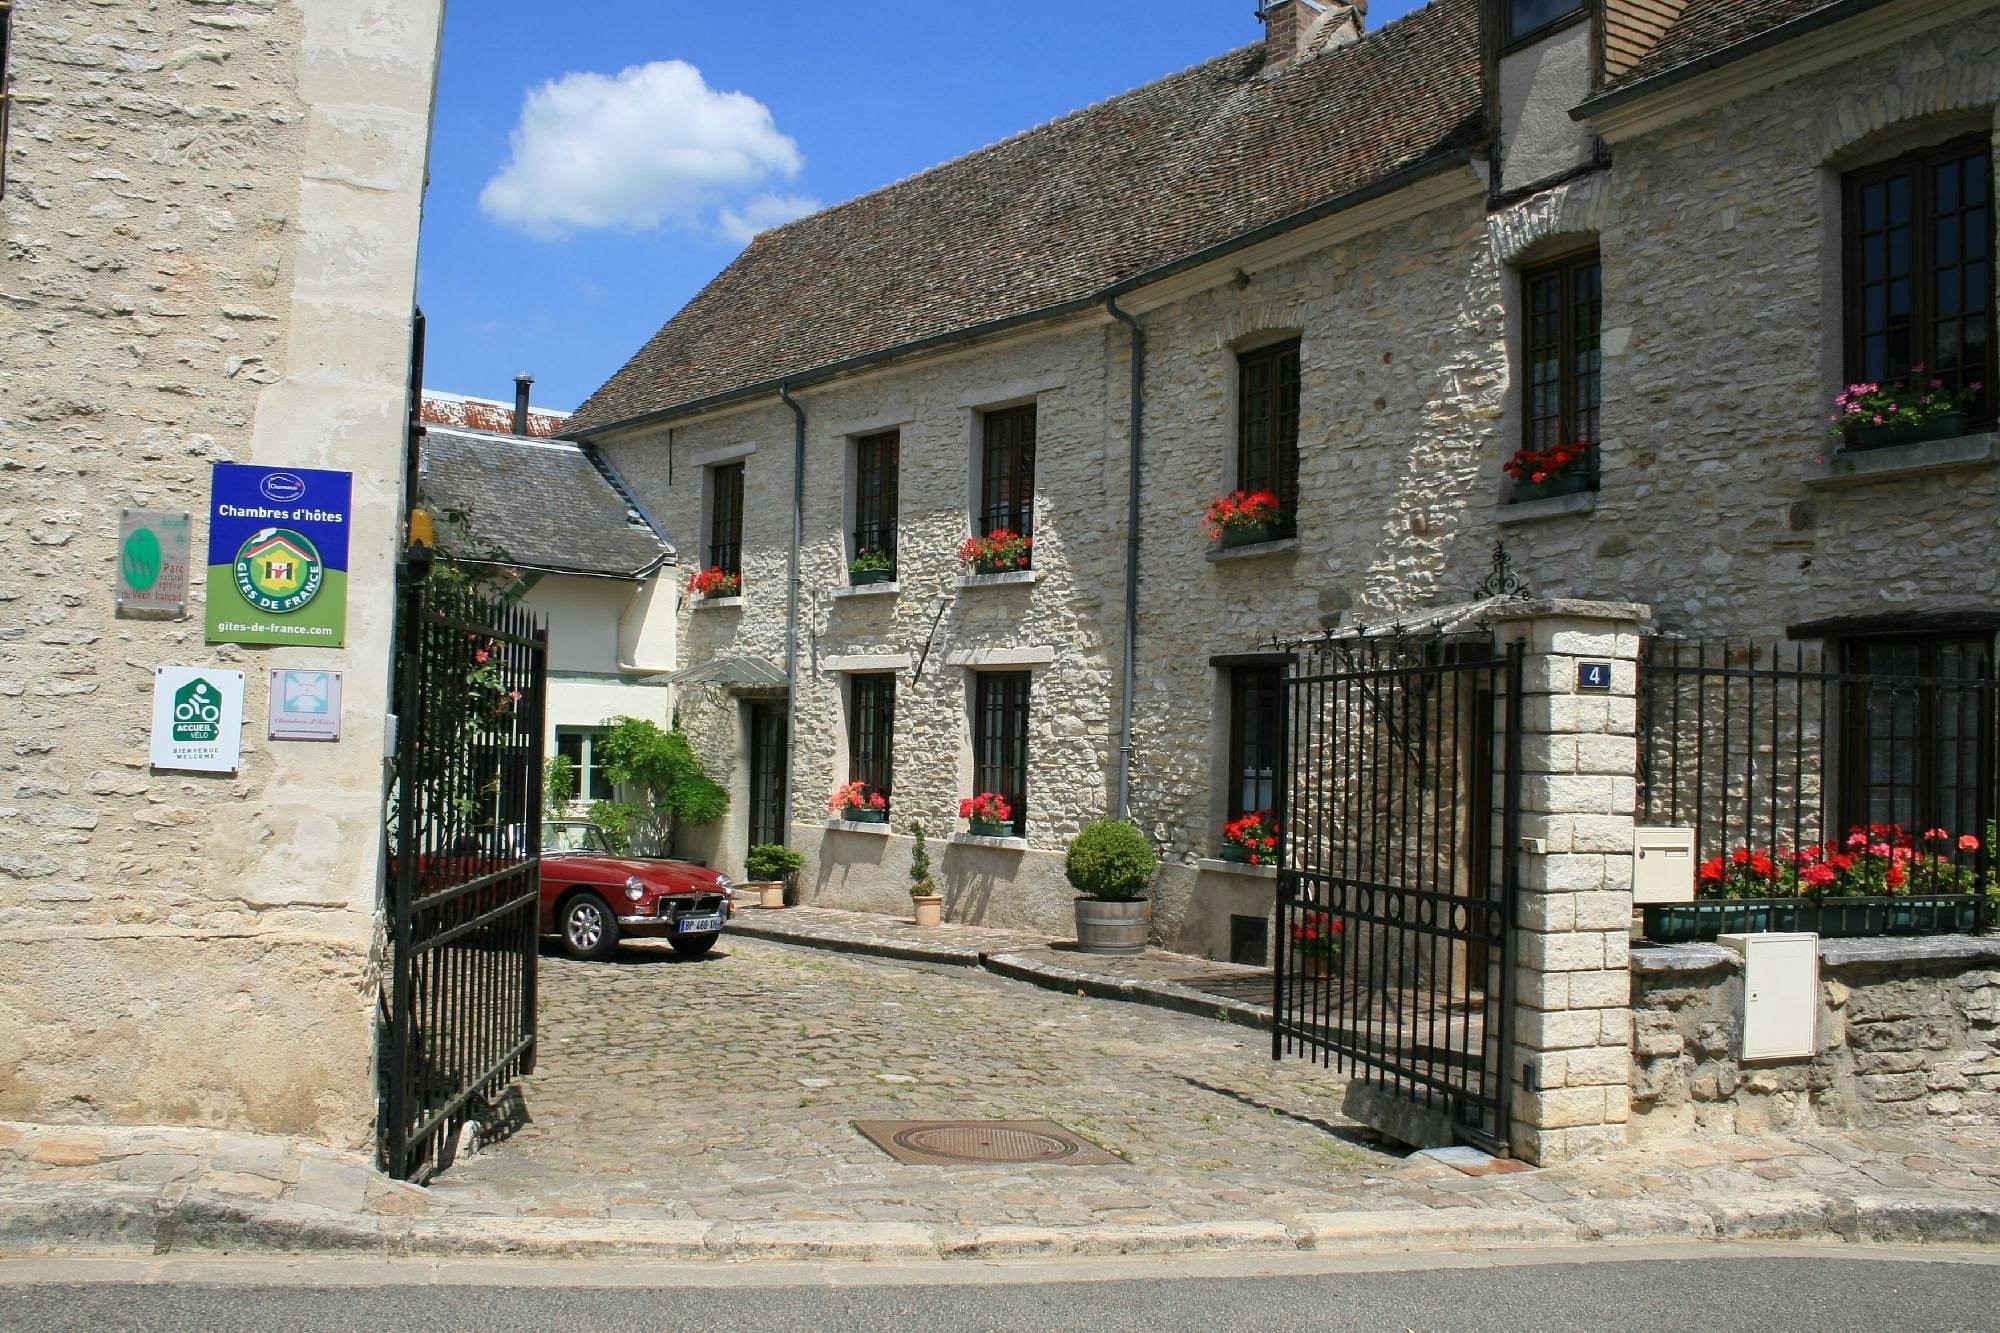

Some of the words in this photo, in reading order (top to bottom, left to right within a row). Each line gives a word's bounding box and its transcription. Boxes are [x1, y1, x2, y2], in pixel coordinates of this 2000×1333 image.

[219, 504, 289, 519] Chambres
[293, 509, 343, 523] d'hôtes
[163, 562, 184, 574] Parc
[260, 597, 279, 610] DE
[284, 565, 319, 608] FRANCE
[218, 621, 333, 636] gites-de-france.com
[1589, 666, 1601, 685] 4
[177, 724, 212, 732] ACCUEIL
